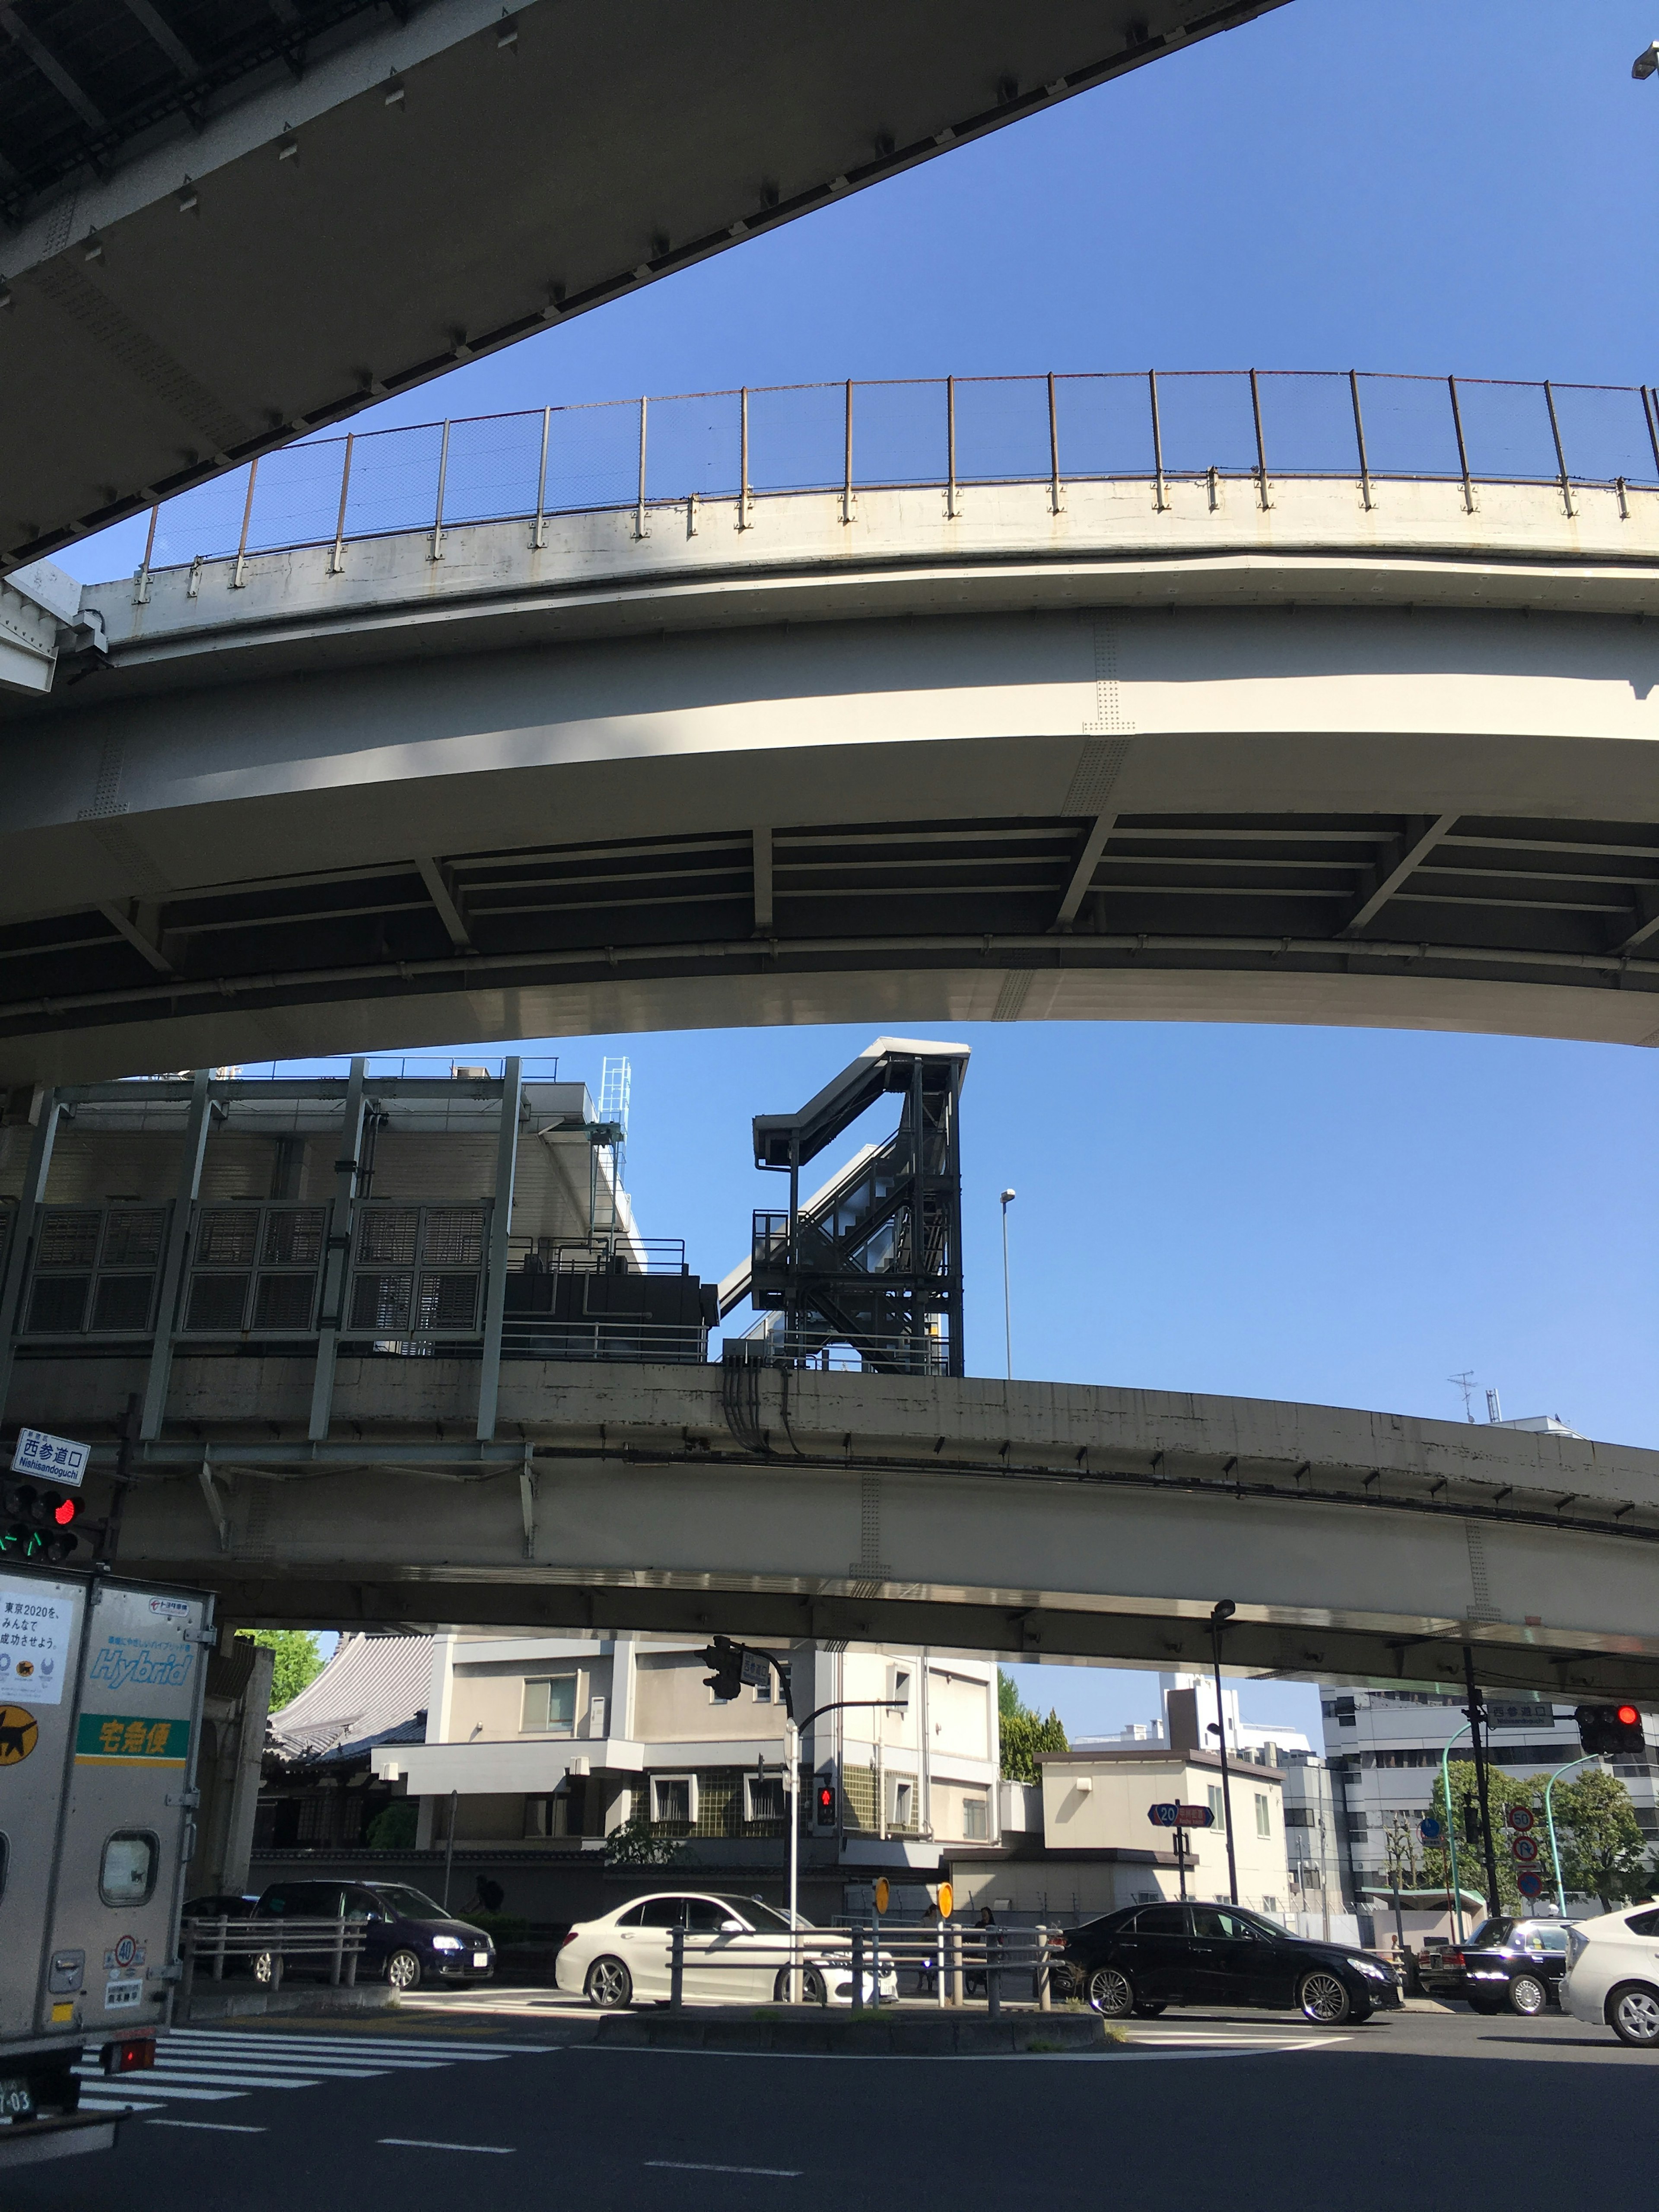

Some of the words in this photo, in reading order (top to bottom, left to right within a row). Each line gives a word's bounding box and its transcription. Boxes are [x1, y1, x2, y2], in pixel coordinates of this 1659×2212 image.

[24, 1439, 82, 1468] 西参道口
[19, 1456, 78, 1479] Nishisandoguchi
[5, 1602, 59, 1619] 東京2020を、
[0, 1633, 57, 1650] 成功させよう。
[90, 1648, 194, 1689] Hybrid
[1493, 1707, 1546, 1717] 西参道口
[99, 1719, 172, 1754] 宅急便
[1161, 1807, 1175, 1821] 20
[1514, 1814, 1529, 1824] 50
[119, 1941, 131, 1960] 40
